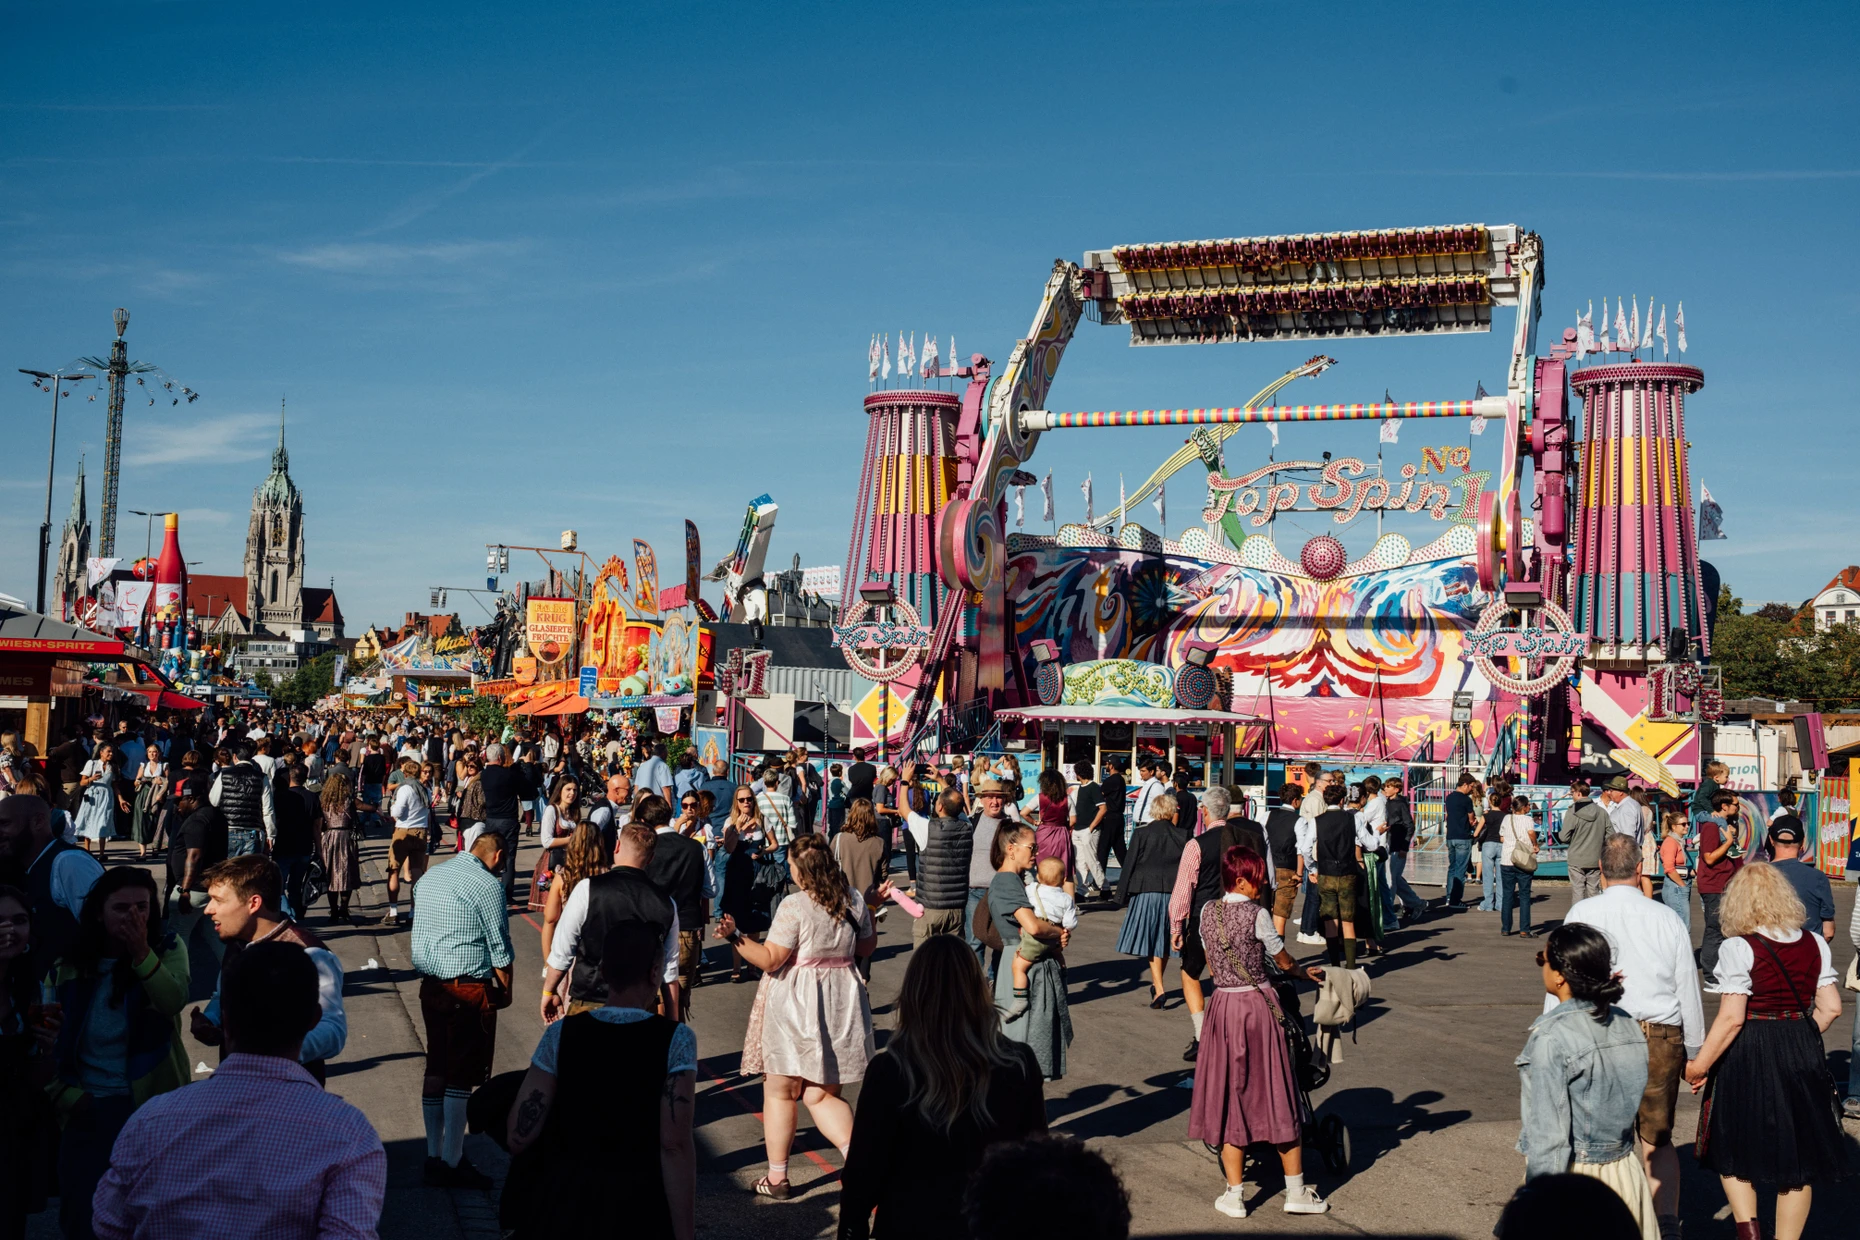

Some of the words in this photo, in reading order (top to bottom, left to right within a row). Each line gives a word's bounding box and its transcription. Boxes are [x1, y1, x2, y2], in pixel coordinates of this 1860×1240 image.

[1202, 459, 1327, 528] Top
[1307, 457, 1452, 524] Spin
[528, 624, 573, 634] GLASIERTE
[536, 613, 567, 622] KRUG
[0, 640, 95, 651] WIESN-SPRITZ
[434, 635, 472, 654] Musi
[831, 621, 880, 651] Top
[872, 621, 929, 650] Spin
[1463, 626, 1521, 660] Top
[1513, 626, 1586, 659] Spin
[1064, 659, 1122, 706] Top
[1109, 659, 1174, 709] Spin
